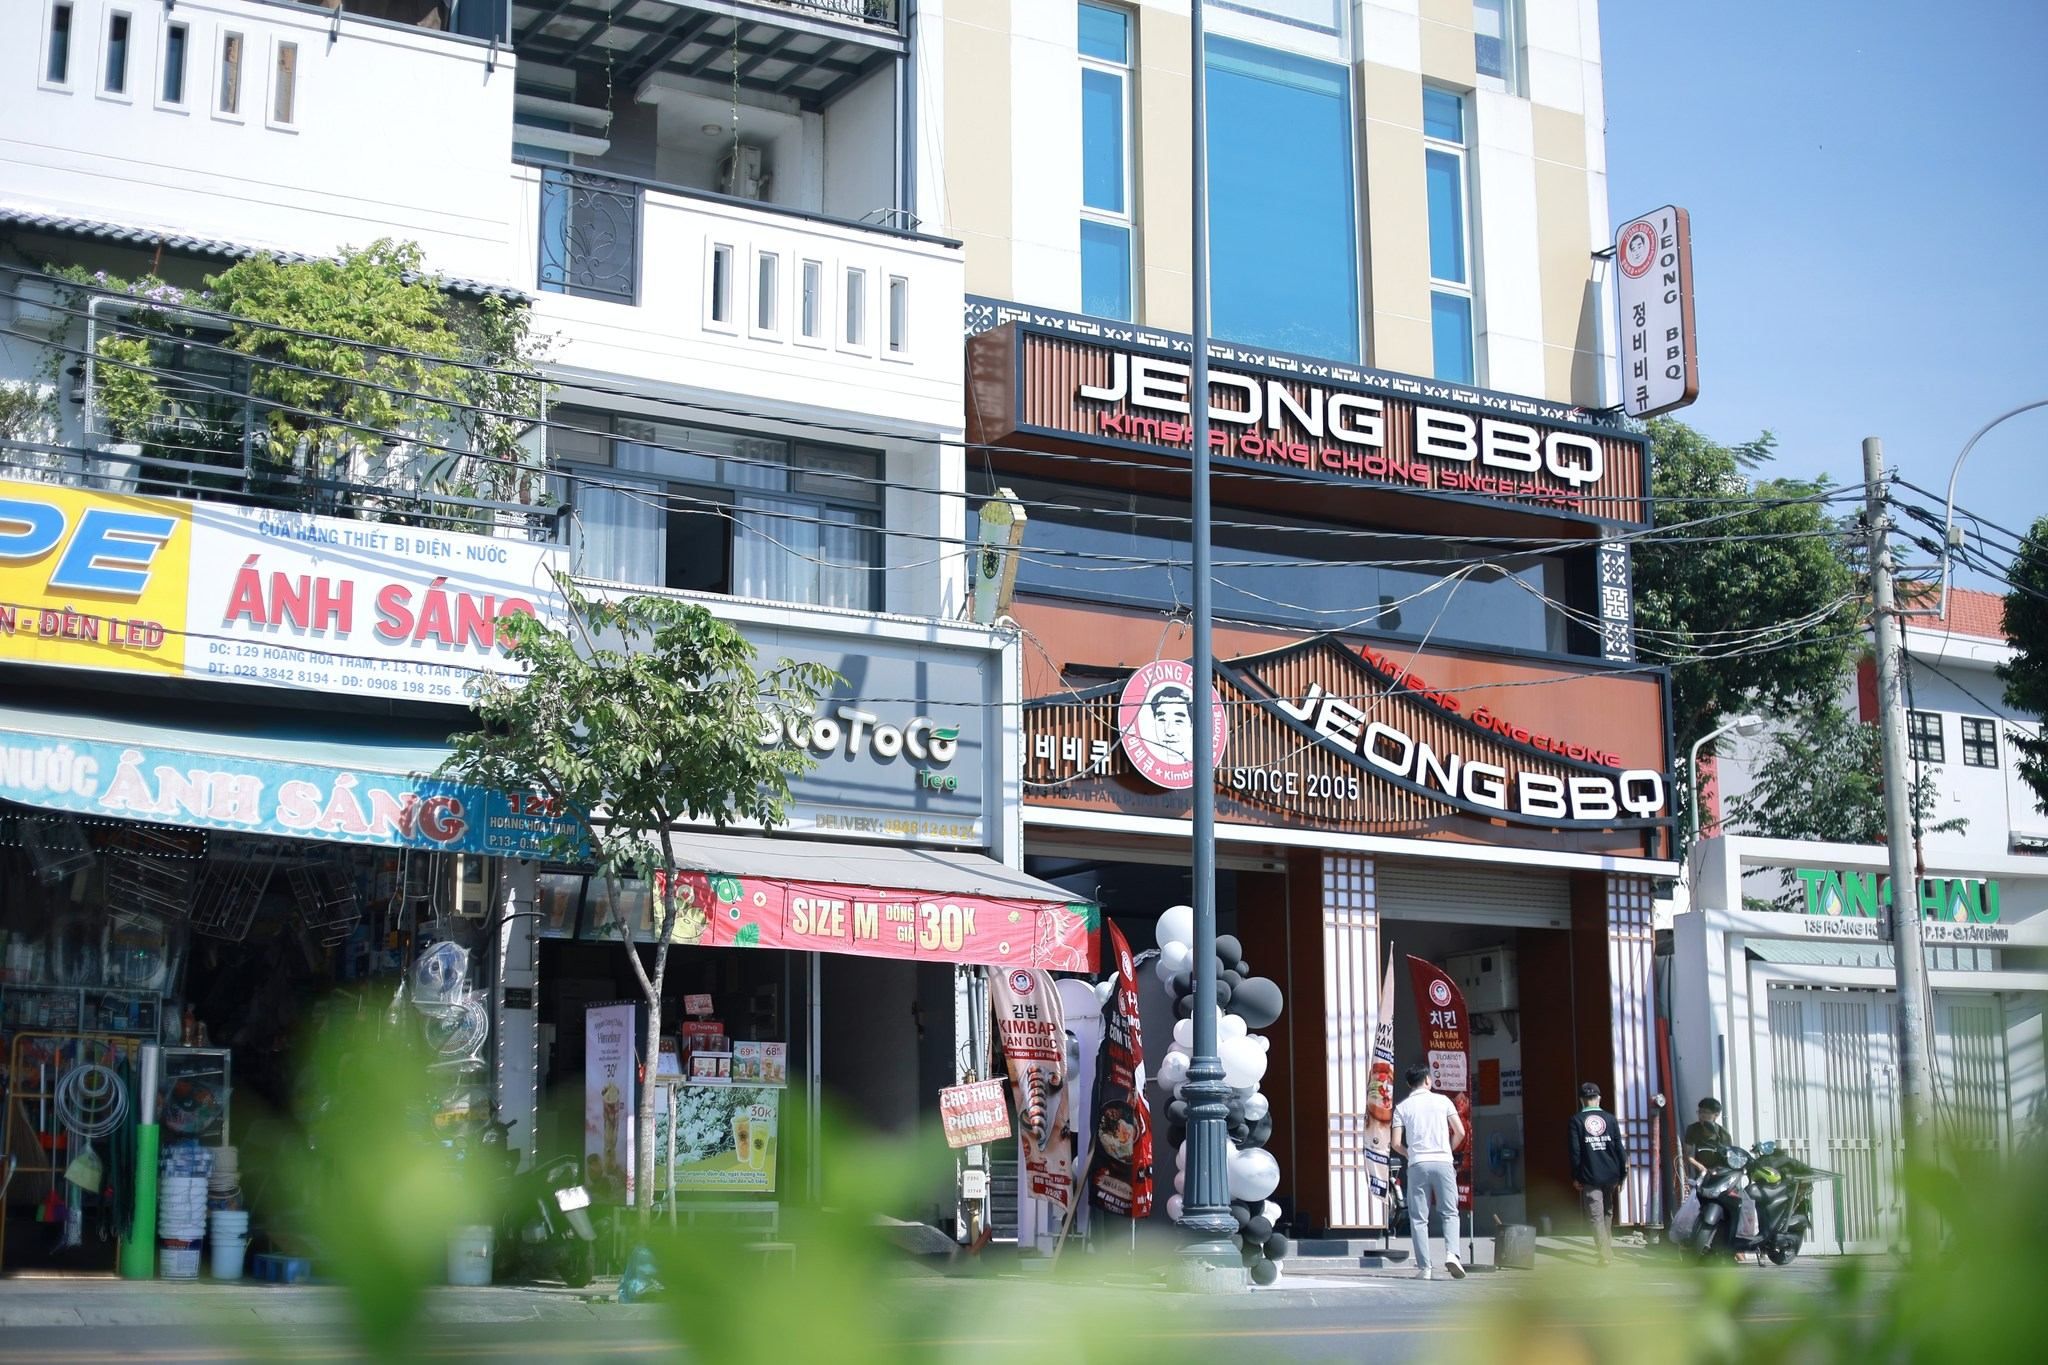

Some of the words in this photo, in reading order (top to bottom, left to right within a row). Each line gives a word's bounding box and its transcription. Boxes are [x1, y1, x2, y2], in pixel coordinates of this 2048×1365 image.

[1660, 218, 1678, 304] JEONG
[1633, 301, 1650, 411] 정비비큐
[1665, 326, 1682, 380] BBQ
[1080, 352, 1384, 448] JEONG
[1416, 406, 1604, 488] BBQ
[1441, 469, 1514, 495] SINCE
[343, 527, 389, 551] THIẾT
[394, 535, 411, 556] BỊ
[415, 537, 451, 560] ĐIỆN
[466, 542, 508, 564] NƯỚC
[225, 553, 354, 634] ÁNH
[109, 617, 165, 649] LED
[209, 642, 231, 656] ĐC:
[235, 645, 259, 658] 129
[208, 661, 230, 674] ĐT:
[233, 664, 258, 677] 028
[262, 667, 294, 681] 3842
[297, 671, 329, 685] 8194
[367, 677, 398, 691] 0908
[402, 681, 425, 694] 198
[429, 683, 451, 696] 256
[1140, 664, 1183, 688] JEONG
[1023, 732, 1110, 776] 비비큐
[1277, 681, 1505, 811] JEONG
[1518, 769, 1665, 821] BBQ
[98, 749, 264, 825] ÁNH
[276, 771, 469, 844] SÁNG
[919, 767, 959, 790] Tea
[1233, 768, 1299, 796] SINCE
[1307, 774, 1358, 801] 2005
[792, 896, 846, 938] SIZE
[854, 901, 880, 941] M
[896, 924, 915, 944] GIÁ
[998, 1018, 1057, 1037] KIMBAP
[1011, 1003, 1039, 1019] 김밥
[1429, 1009, 1458, 1030] 치킨
